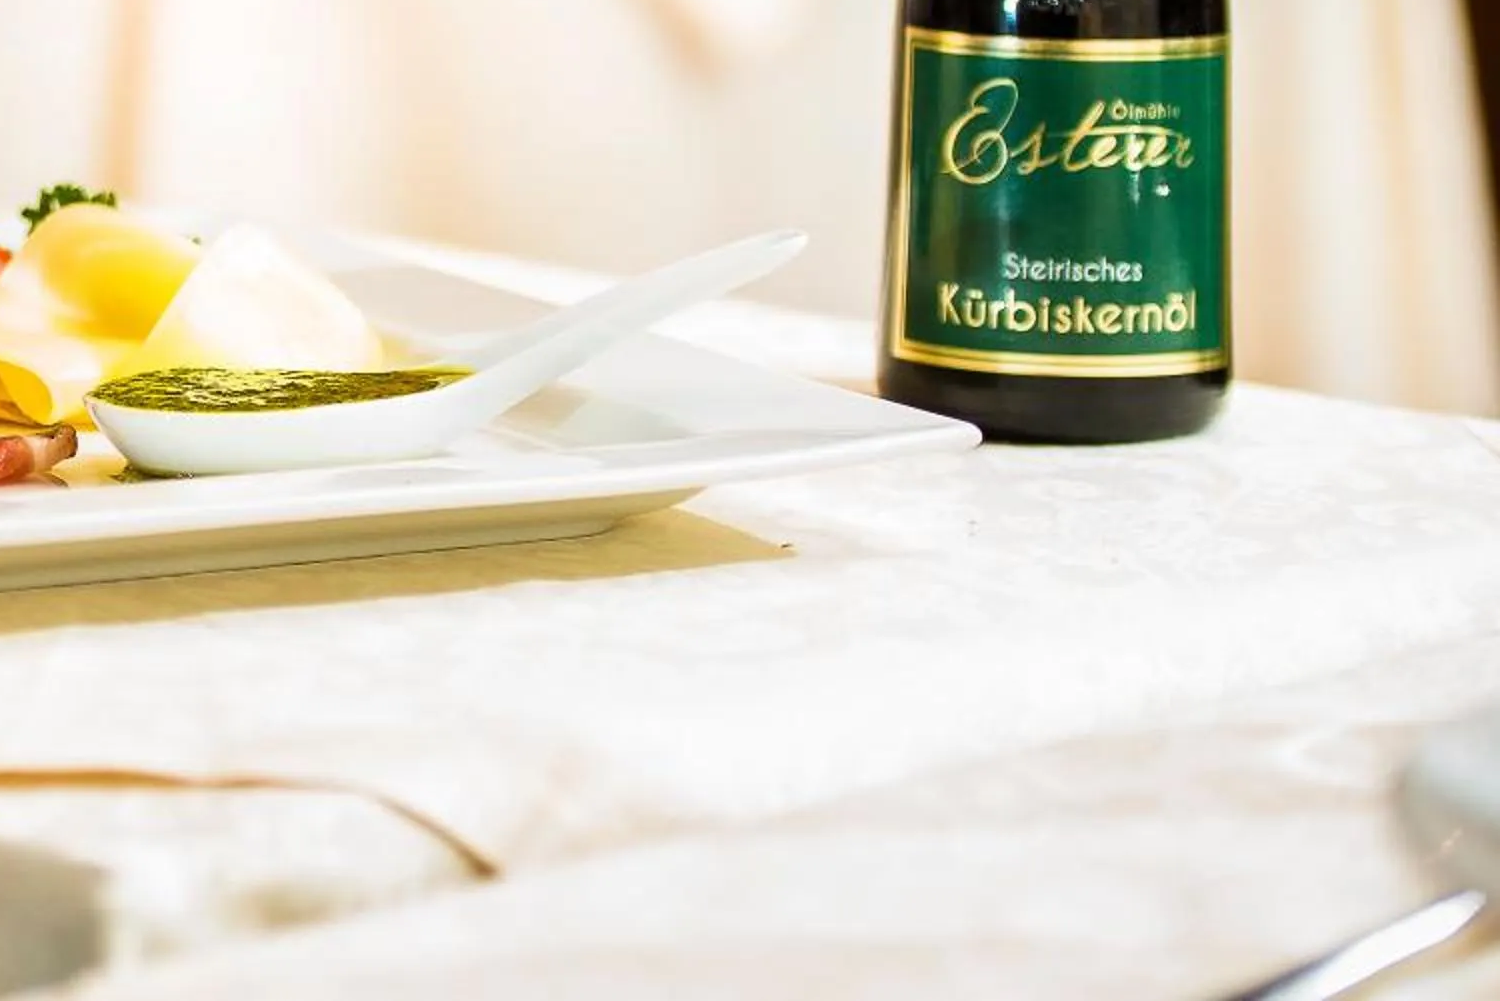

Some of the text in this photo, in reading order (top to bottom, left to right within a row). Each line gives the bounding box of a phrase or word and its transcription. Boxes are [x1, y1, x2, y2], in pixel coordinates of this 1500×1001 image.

[938, 77, 1195, 185] Esterer
[1004, 251, 1143, 283] Steirisches
[938, 282, 1197, 335] Kürbiskernöl
